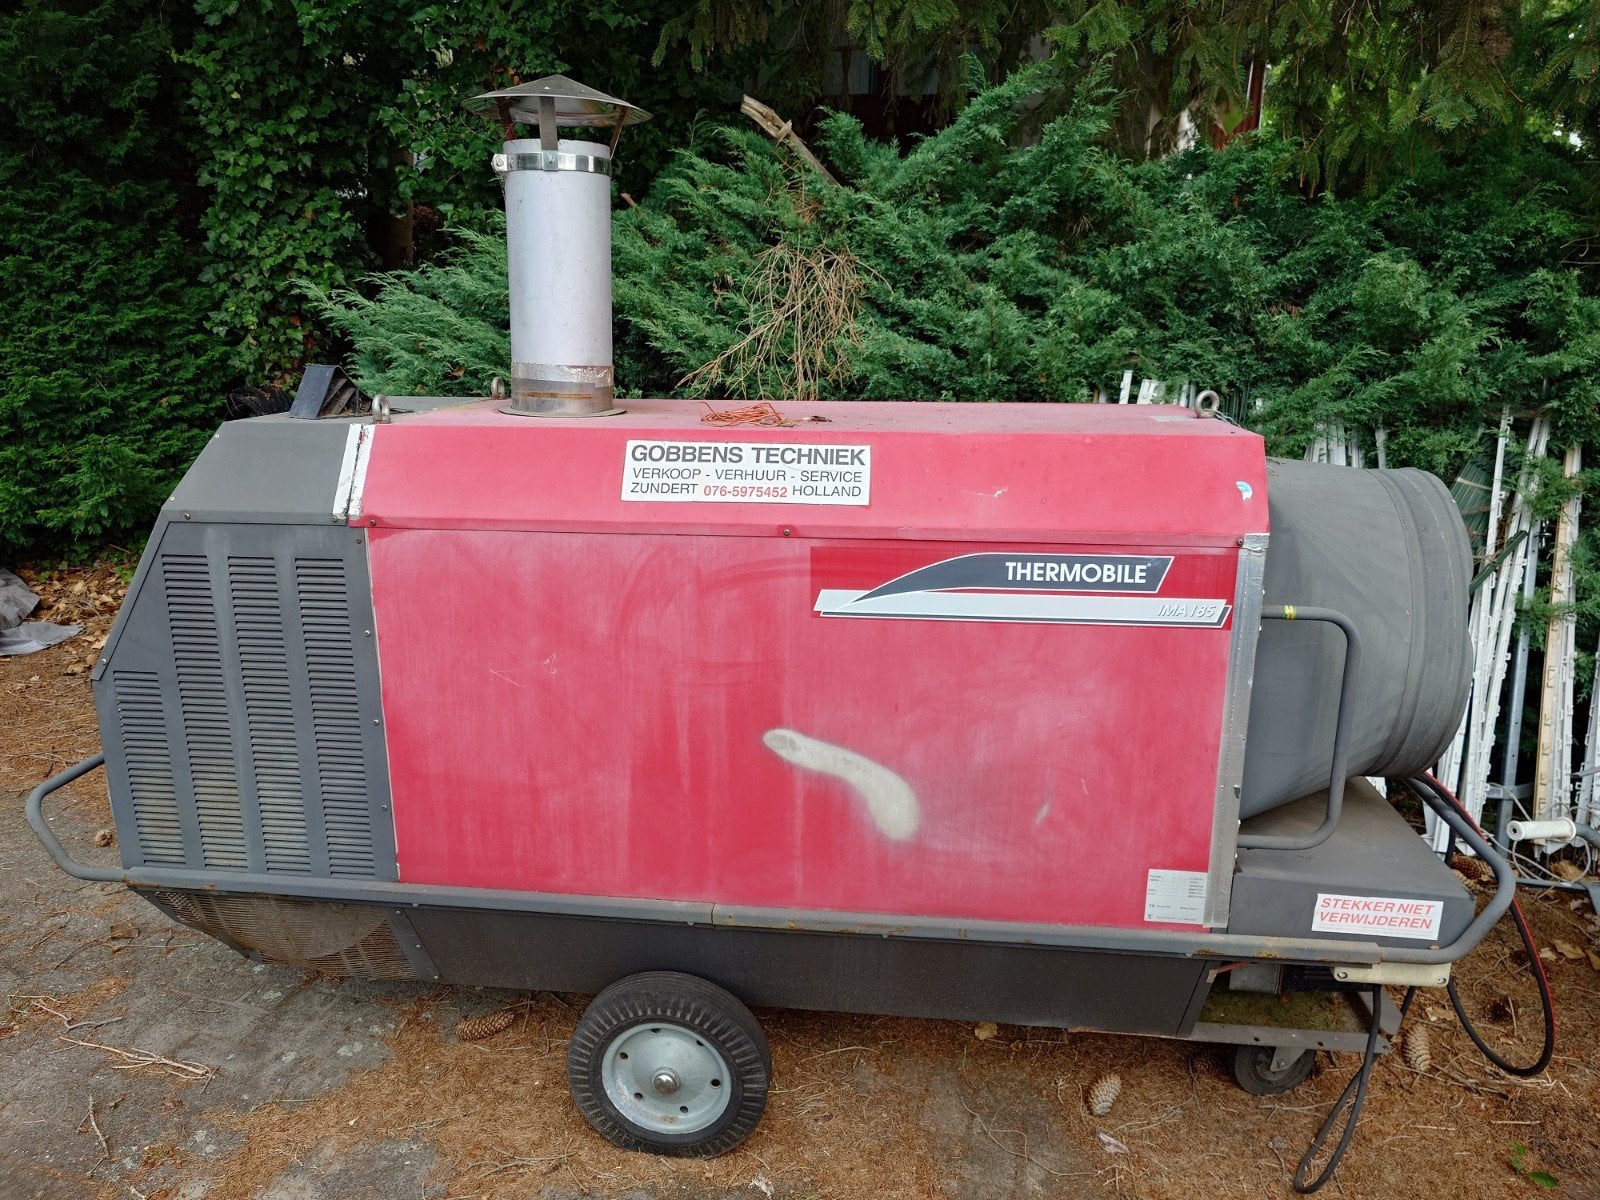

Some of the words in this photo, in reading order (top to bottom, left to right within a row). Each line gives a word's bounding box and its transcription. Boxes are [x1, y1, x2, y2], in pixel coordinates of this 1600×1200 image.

[631, 444, 743, 464] GOBBENS
[751, 447, 866, 466] TECHNIEK
[632, 467, 701, 480] VERKOOP
[715, 468, 786, 482] VERHUUR
[800, 470, 863, 483] SERVICE
[630, 482, 698, 495] ZUNDERT
[703, 485, 788, 498] 076-5975452
[792, 485, 861, 497] HOLLAND
[1005, 561, 1147, 583] THERMOBILE
[1156, 604, 1187, 617] IMA
[1190, 605, 1216, 618] 185
[1321, 898, 1395, 912] STEKKER
[1398, 903, 1435, 915] NIET
[1320, 912, 1432, 929] VERWIJDEREN
